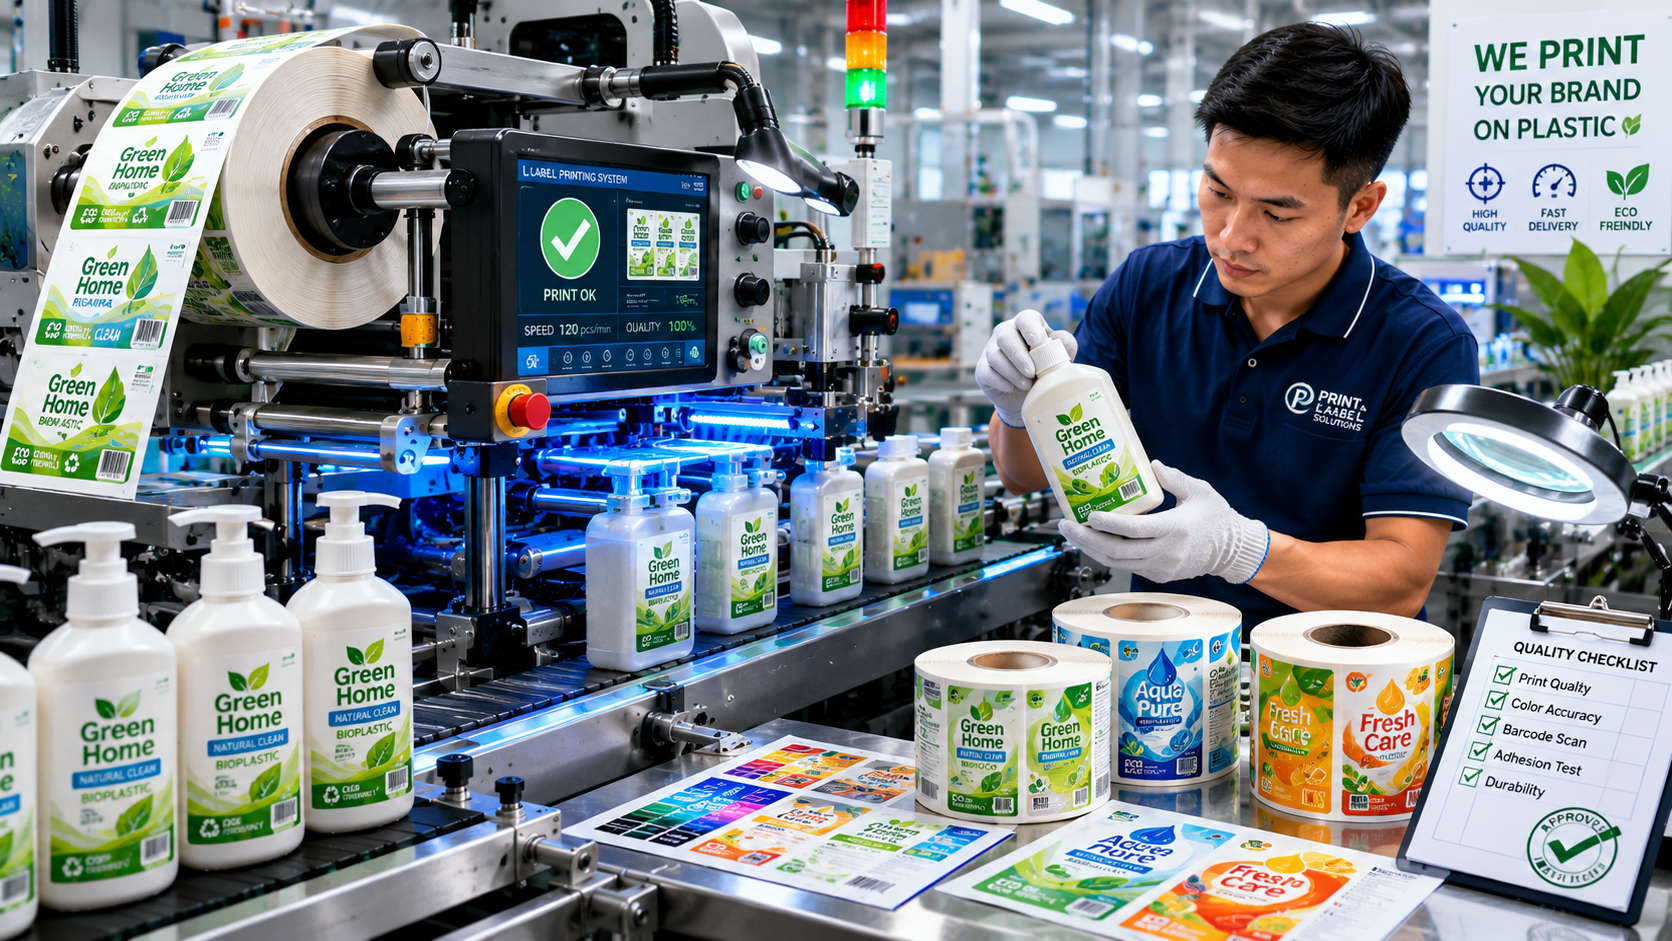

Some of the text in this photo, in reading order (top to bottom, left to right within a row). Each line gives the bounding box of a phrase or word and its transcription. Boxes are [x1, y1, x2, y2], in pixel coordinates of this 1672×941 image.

[1474, 34, 1646, 73] WE PRINT
[171, 71, 218, 82] Green
[1474, 78, 1641, 106] YOUR BRAND
[1474, 115, 1616, 141] ON PLASTIC
[120, 146, 167, 162] Green
[112, 163, 160, 180] Home
[559, 169, 596, 182] PRINTING
[597, 172, 628, 185] SYSTEM
[1472, 209, 1498, 219] HIGH
[1541, 208, 1567, 218] FAST
[1614, 207, 1638, 217] ECO
[1463, 222, 1507, 232] QUALITY
[1528, 221, 1579, 231] DELIVERY
[81, 256, 129, 277] Green
[75, 276, 123, 296] Home
[543, 288, 597, 302] PRINT OK
[524, 325, 555, 337] SPEED
[559, 323, 579, 336] 120
[668, 320, 697, 332] 100%
[48, 374, 96, 397] Green
[42, 394, 90, 417] Home
[1318, 390, 1362, 410] PRINT
[1055, 417, 1101, 443] Green
[1313, 413, 1362, 431] SOLUTIONS
[1061, 429, 1105, 456] Home
[831, 512, 854, 524] Green
[740, 532, 767, 545] Green
[831, 522, 854, 535] Home
[741, 543, 767, 557] Home
[648, 557, 680, 573] Green
[649, 570, 680, 586] Home
[1513, 641, 1658, 673] QUALITY CHECKLIST
[334, 664, 395, 687] Green
[1518, 672, 1548, 688] Print
[214, 690, 282, 713] Green
[336, 682, 396, 706] Home
[1135, 681, 1182, 703] Aqua
[373, 705, 397, 718] CLEAN
[1138, 699, 1183, 717] Pure
[1269, 701, 1311, 725] Fresh
[1511, 698, 1602, 726] Color Accuracy
[80, 718, 155, 742] Green
[216, 710, 283, 735] Home
[336, 721, 393, 740] BIOPLASTIC
[960, 718, 1004, 736] Green
[1040, 722, 1081, 738] Green
[1360, 709, 1415, 732] Fresh
[213, 733, 284, 753] NATURAL CLEAN
[961, 733, 1004, 749] Home
[1042, 735, 1081, 751] Home
[1364, 732, 1412, 752] Care
[1502, 724, 1588, 749] Barcode Scan
[82, 739, 155, 766] Home
[215, 750, 280, 771] BIOPLASTIC
[1493, 749, 1583, 777] Adhesion Test
[79, 764, 157, 784] NATURAL CLEAN
[81, 782, 151, 804] BIOPLASTIC
[1484, 776, 1546, 800] Durability
[1220, 876, 1286, 898] Care
